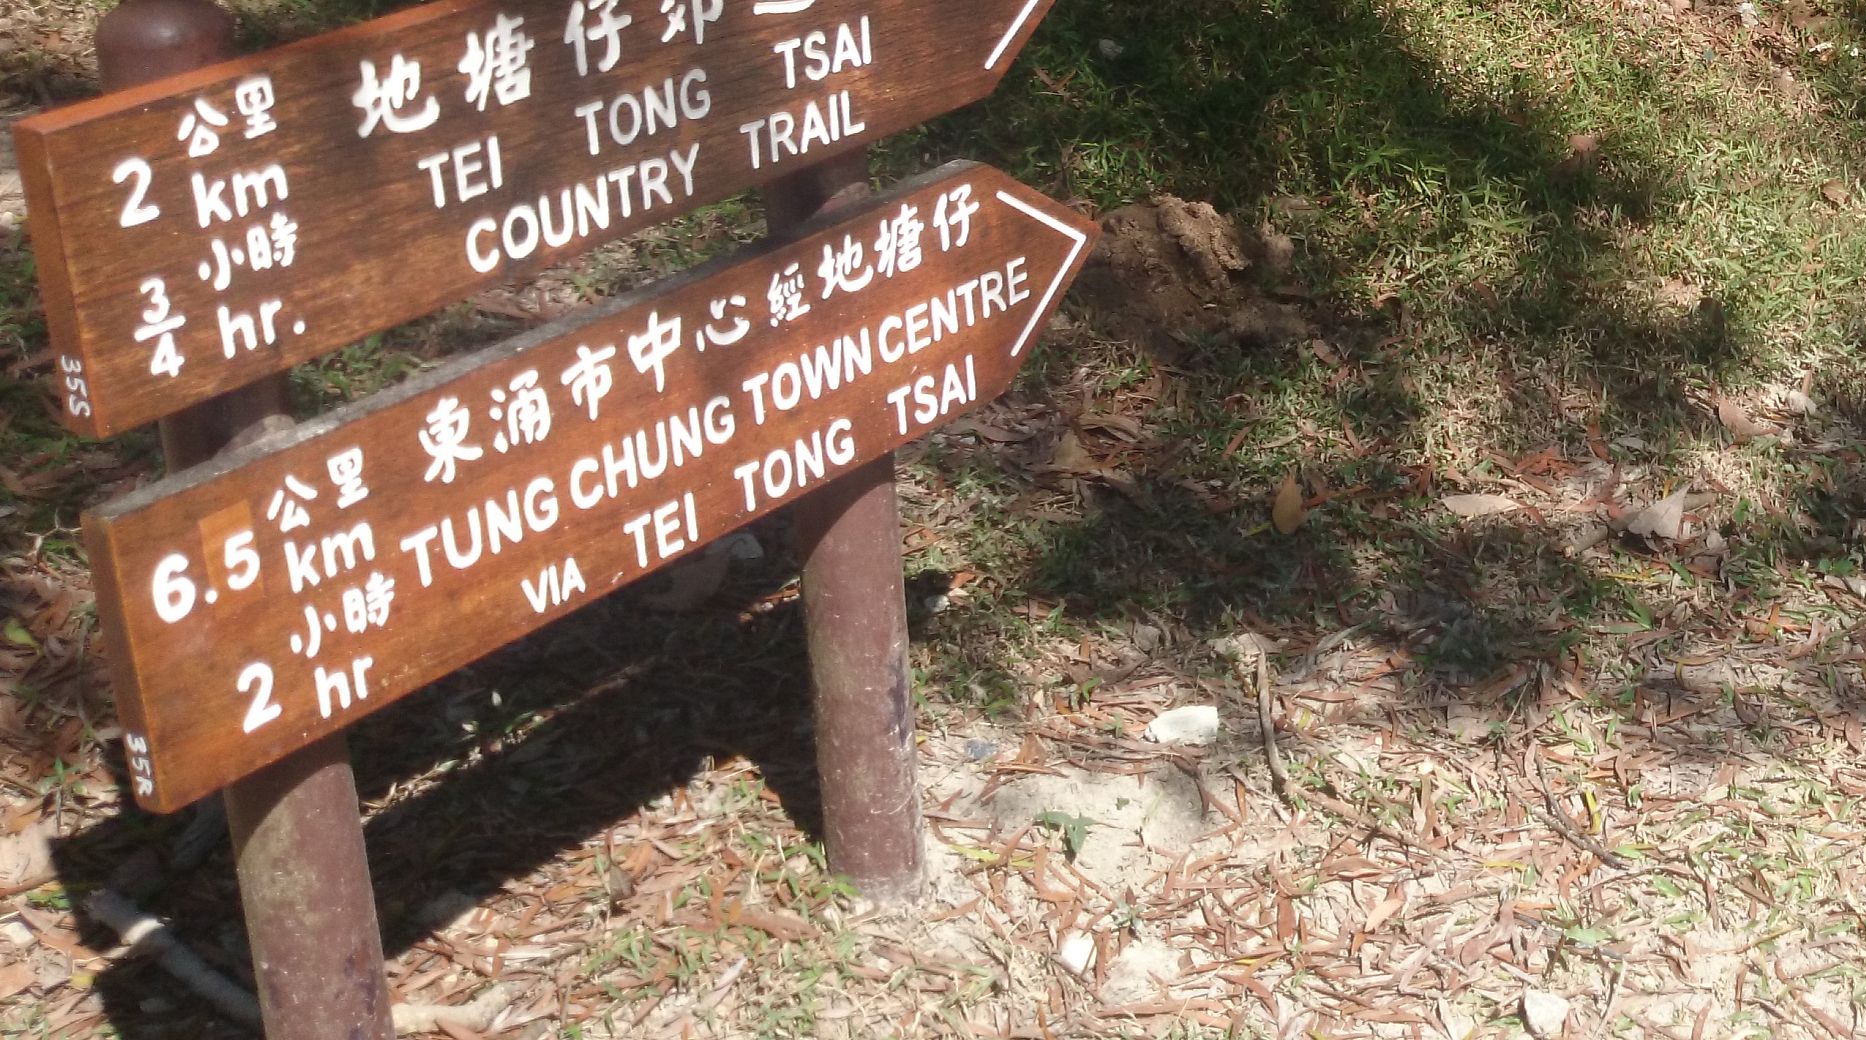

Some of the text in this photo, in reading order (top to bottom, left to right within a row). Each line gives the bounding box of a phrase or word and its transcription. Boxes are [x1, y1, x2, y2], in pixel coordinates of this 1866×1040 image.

[175, 73, 279, 160] 公里
[415, 13, 874, 211] TEI TONG TSAI
[111, 156, 291, 230] 2 km
[463, 88, 867, 275] COUNTRY TRAIL
[195, 207, 300, 293] 小時
[214, 295, 308, 361] hr.
[398, 254, 1032, 589] TUNG CHUNG TOWN CENTRE
[265, 444, 371, 535] 公里
[519, 352, 978, 615] VIA TEI TONG TSAI
[149, 518, 377, 626] 6.5 km
[288, 569, 397, 660] 小時
[235, 654, 375, 735] 2 hr
